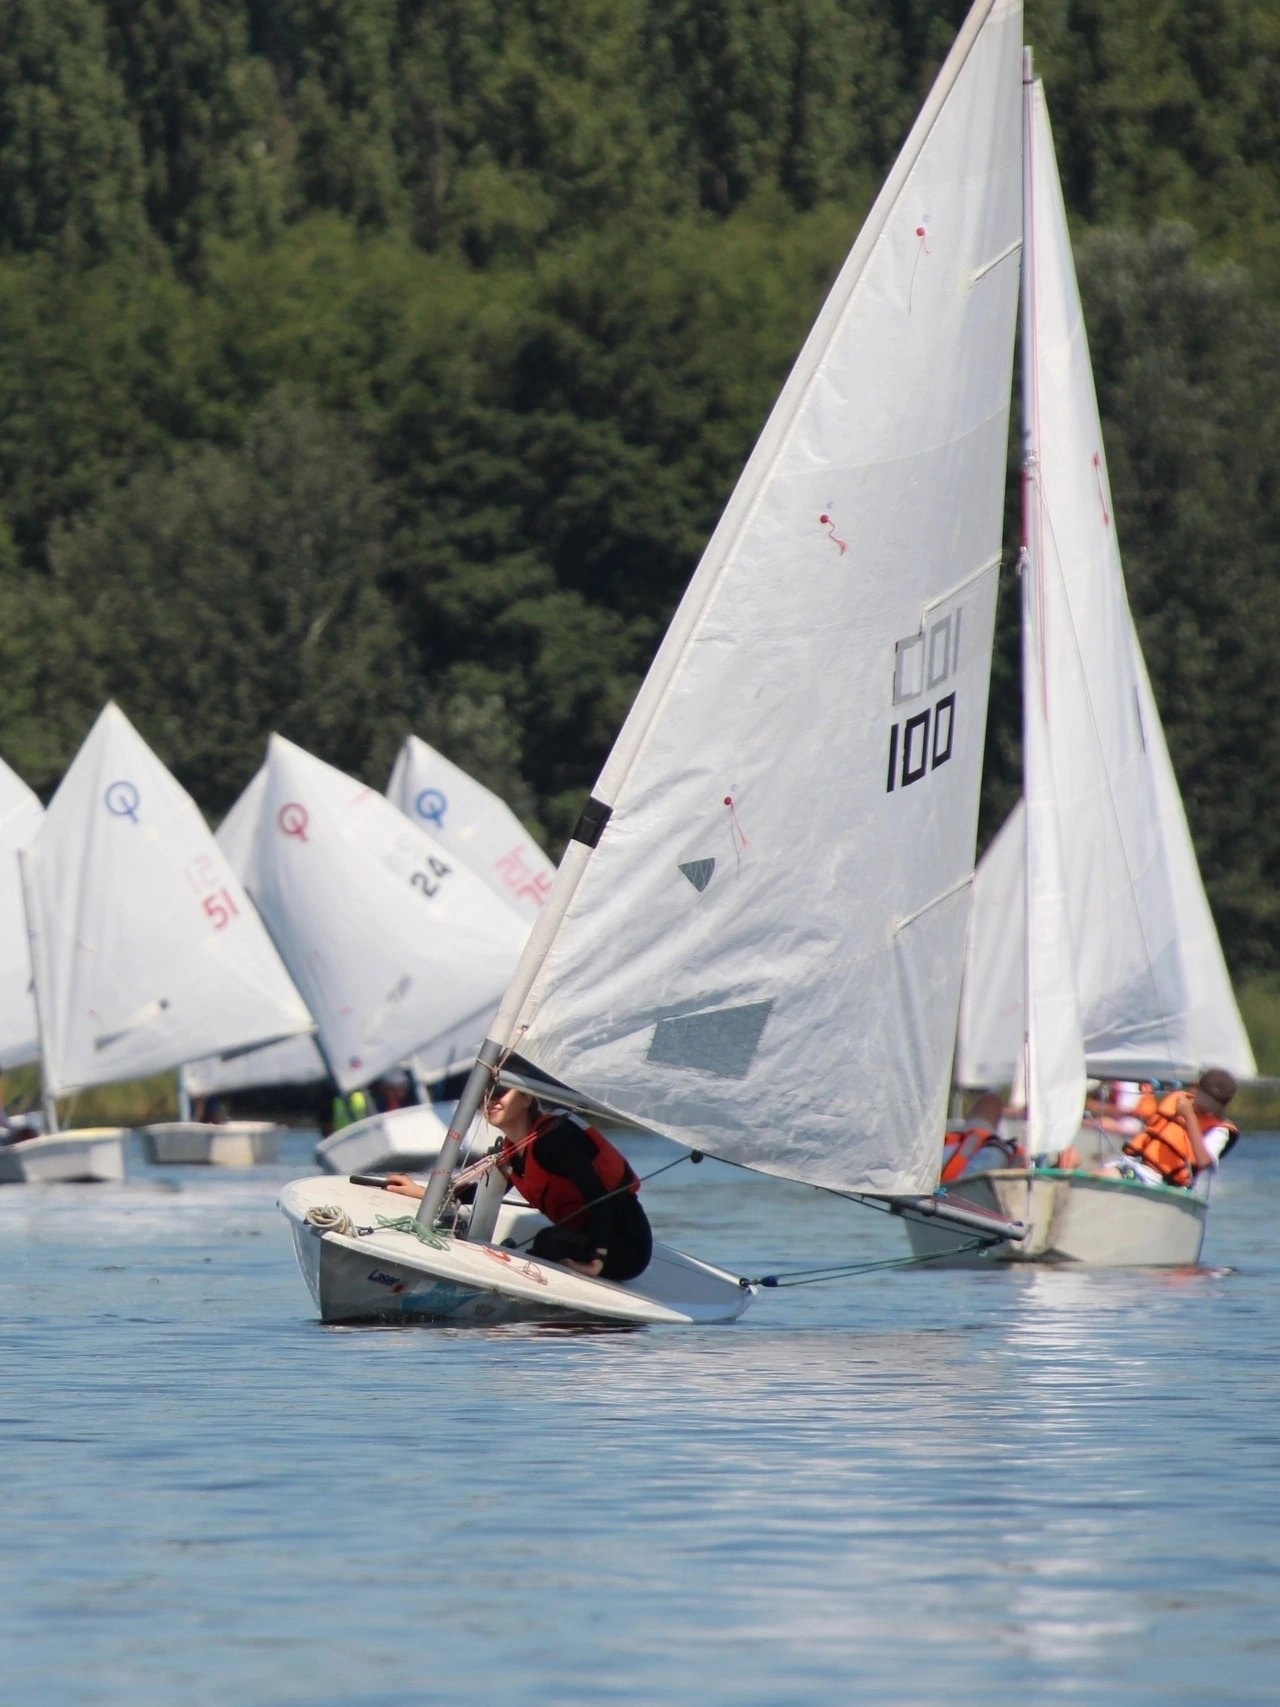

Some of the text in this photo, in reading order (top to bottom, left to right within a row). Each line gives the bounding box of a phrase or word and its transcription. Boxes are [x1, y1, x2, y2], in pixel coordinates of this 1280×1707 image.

[887, 692, 956, 793] 100
[409, 855, 453, 898] 24
[202, 886, 239, 931] 51
